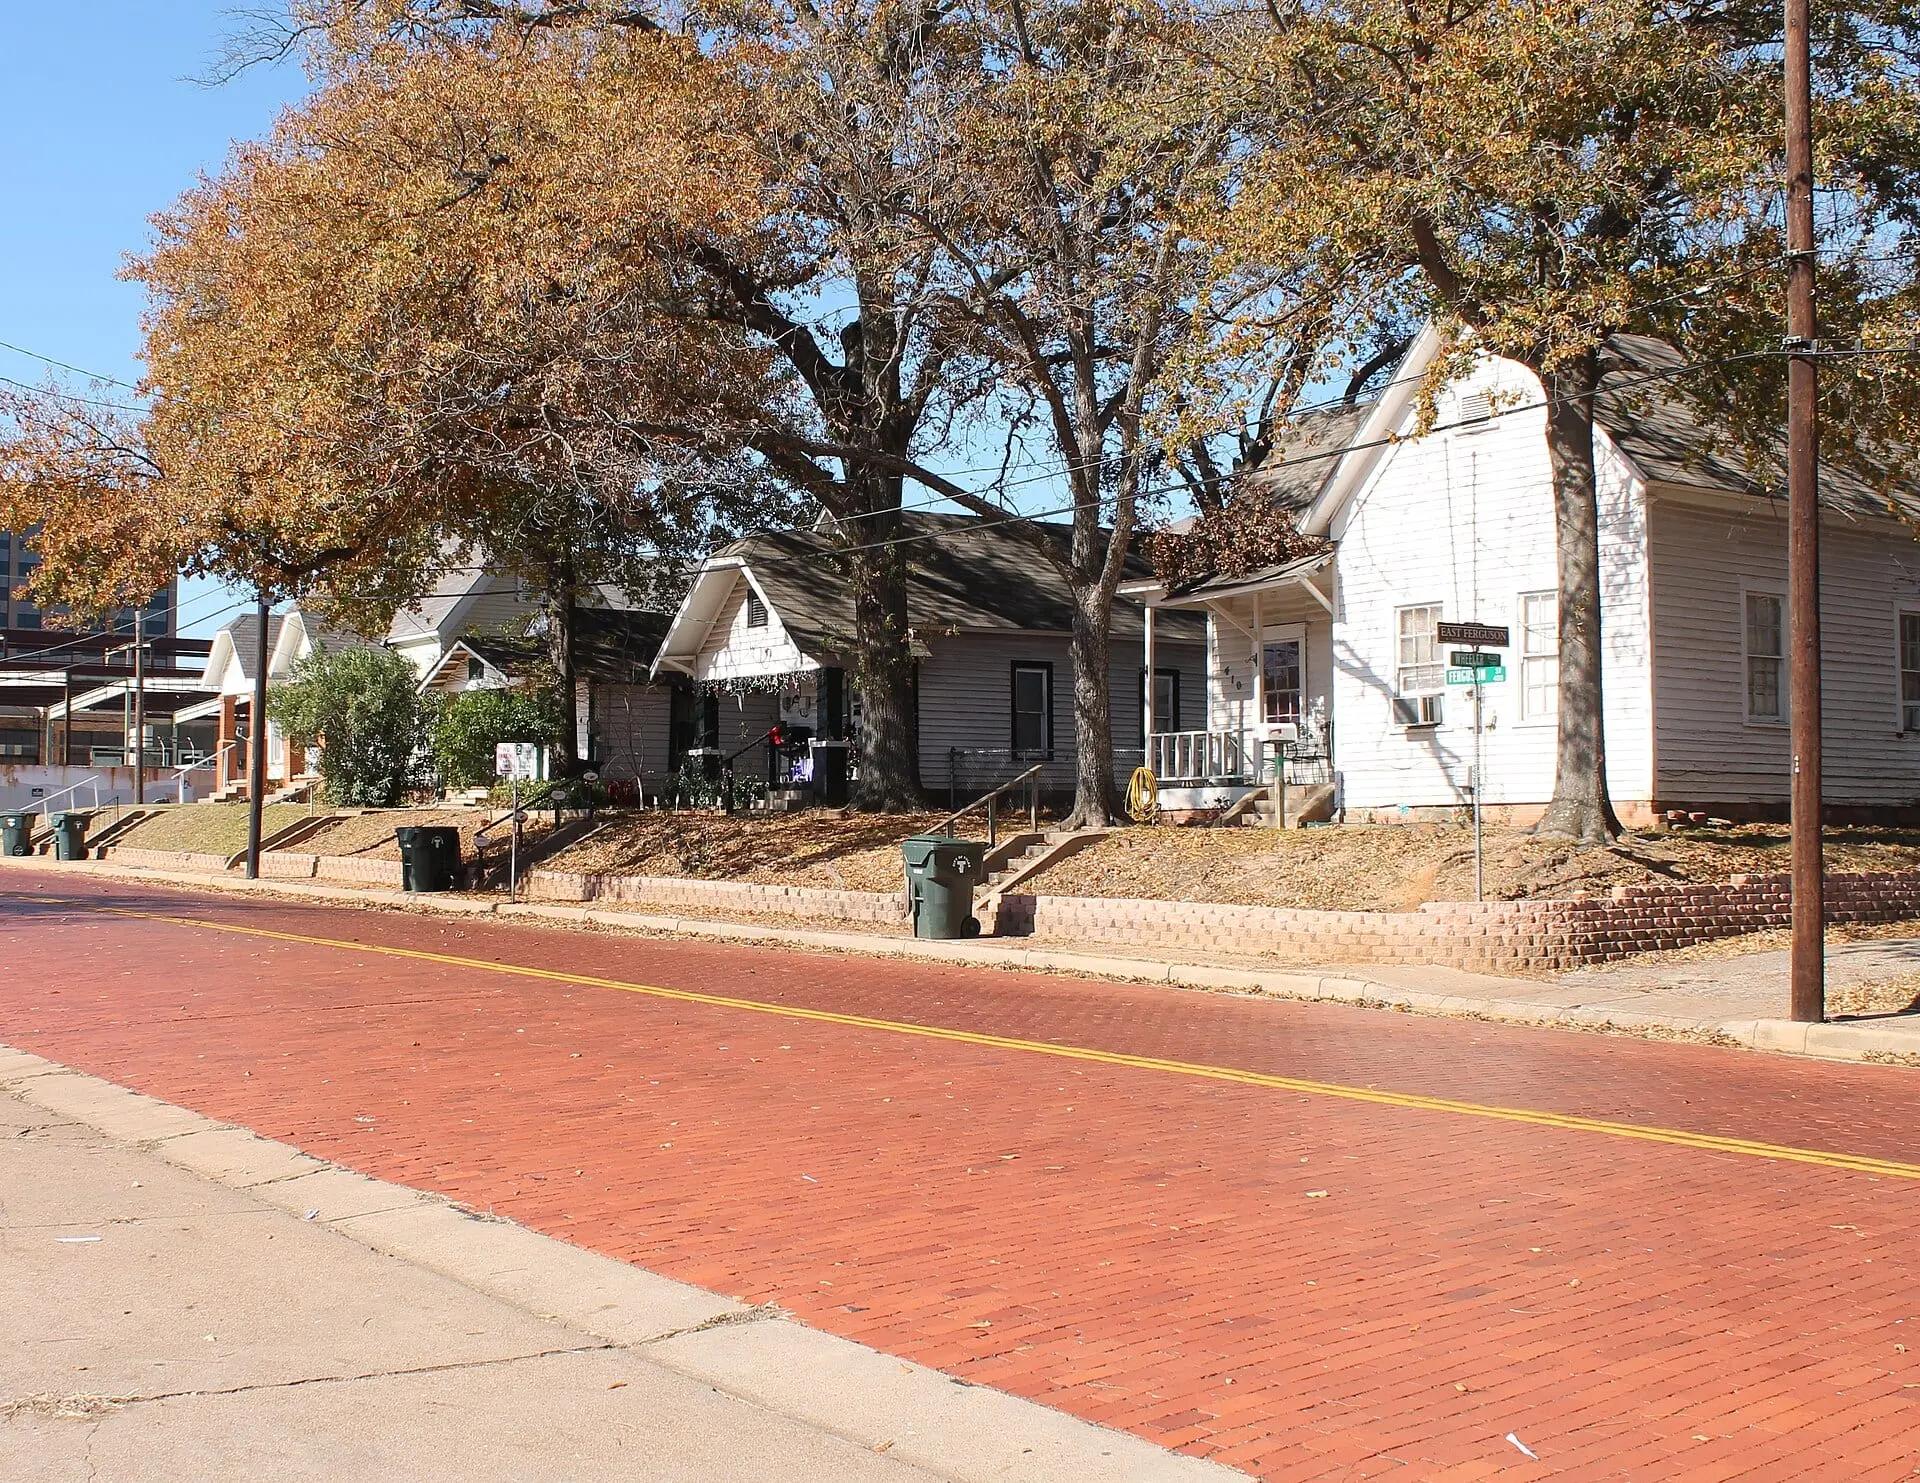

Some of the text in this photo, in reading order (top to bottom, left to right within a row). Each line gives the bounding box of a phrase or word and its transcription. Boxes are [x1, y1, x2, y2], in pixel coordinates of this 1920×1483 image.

[1441, 627, 1462, 638] EAST
[1463, 628, 1507, 641] FERGUSON
[1455, 653, 1484, 665] WHEELER
[1449, 669, 1486, 682] FERGUSON
